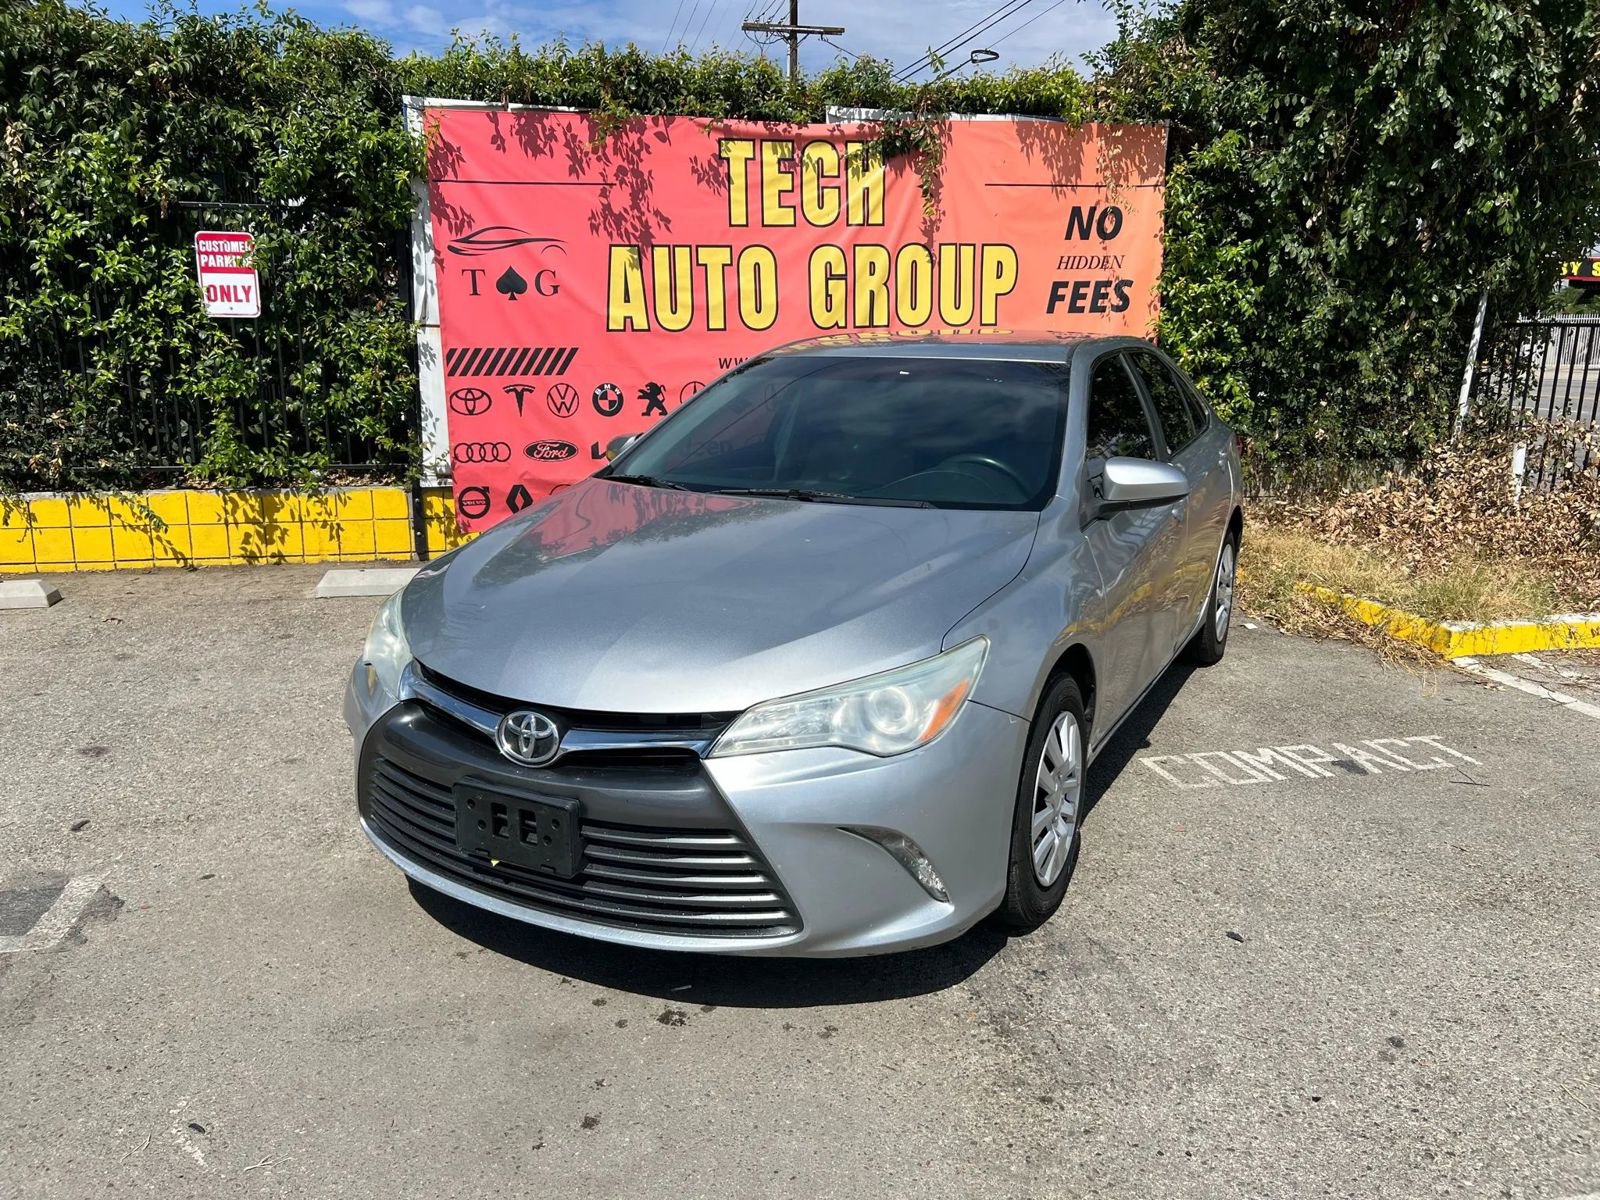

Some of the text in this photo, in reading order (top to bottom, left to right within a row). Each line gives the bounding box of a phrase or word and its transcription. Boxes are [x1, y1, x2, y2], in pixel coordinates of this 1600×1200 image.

[719, 138, 885, 227] TECH
[1064, 205, 1123, 241] NO
[200, 254, 252, 268] PARKI
[1056, 255, 1126, 270] HIDDEN
[207, 284, 252, 303] ONLY
[461, 268, 560, 297] T G
[607, 243, 1019, 332] AUTO GROUP
[1046, 279, 1134, 313] FEES
[533, 442, 569, 458] Ford
[1138, 735, 1483, 789] COMPACT
